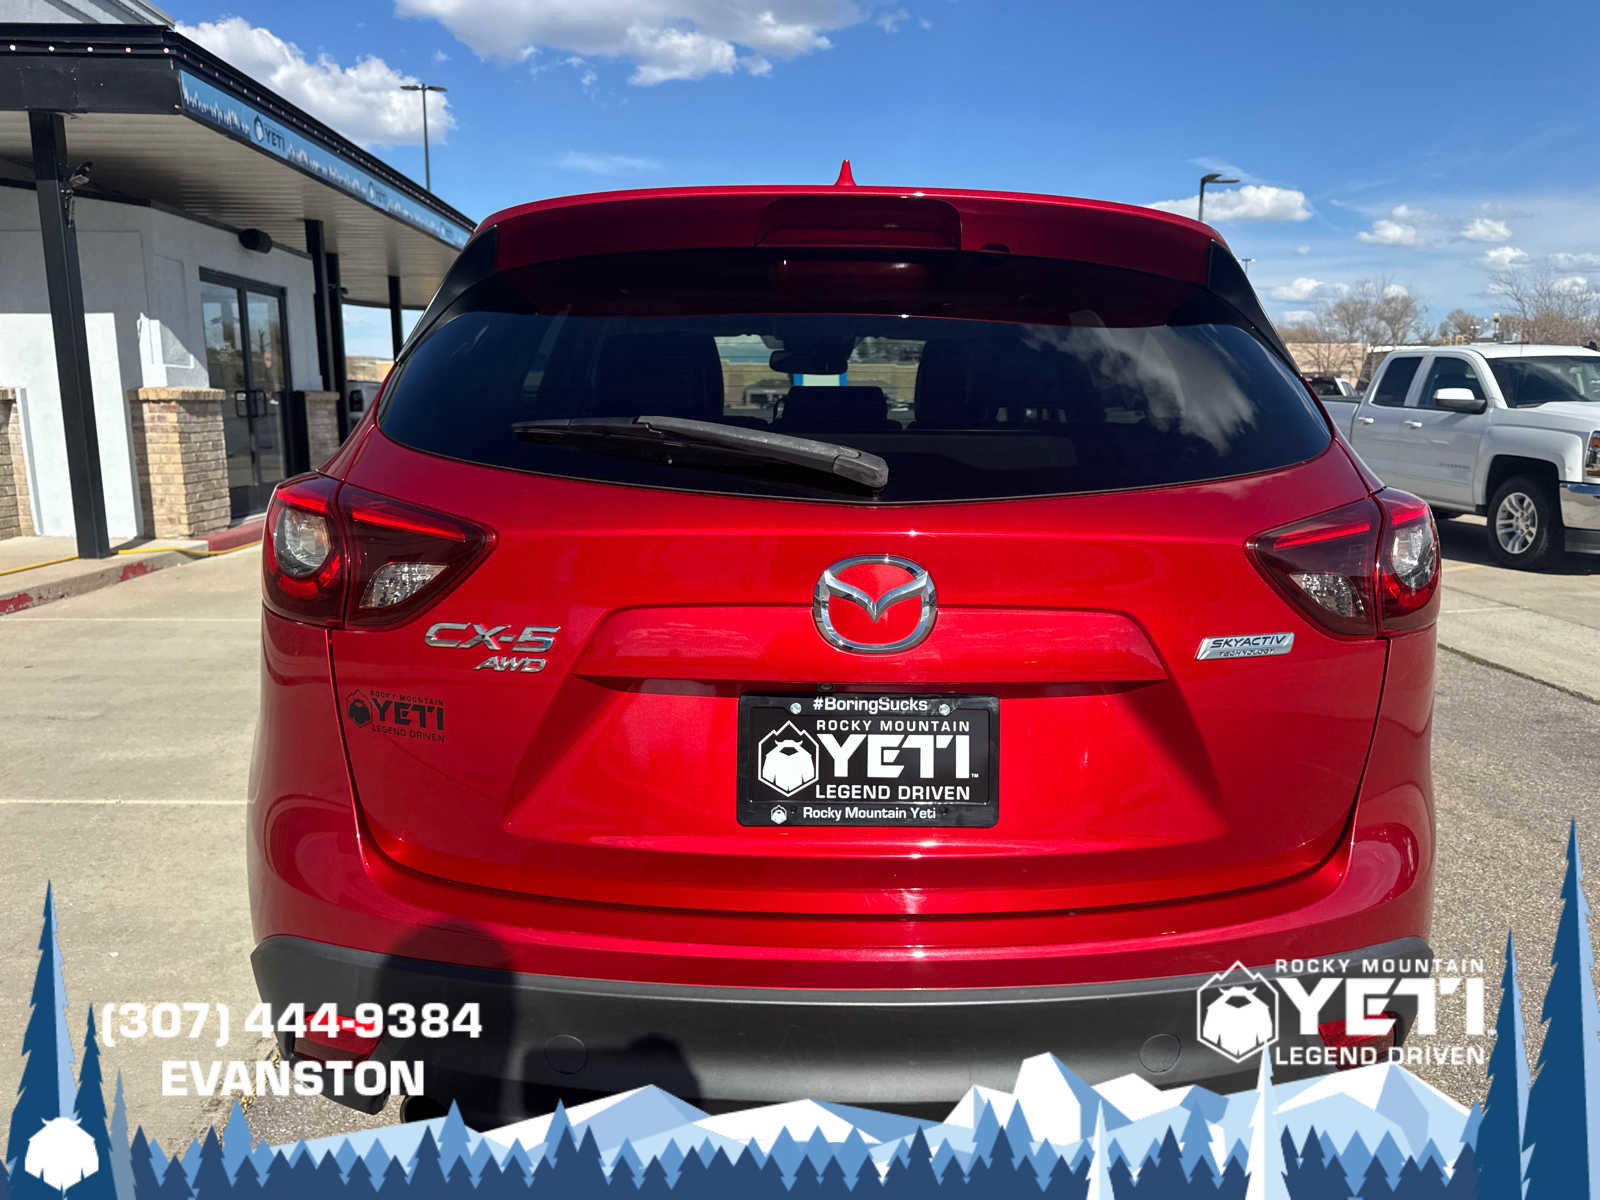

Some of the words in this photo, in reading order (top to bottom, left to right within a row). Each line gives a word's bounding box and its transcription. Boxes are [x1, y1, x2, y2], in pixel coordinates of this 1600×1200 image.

[424, 622, 562, 653] CX-5
[1210, 635, 1287, 649] SKYACTIV
[474, 655, 548, 673] AWD
[369, 690, 395, 700] ROCKY
[399, 694, 444, 706] MOUNTAIN
[813, 696, 928, 714] #BoringSucks
[372, 698, 444, 731] YETI
[372, 724, 406, 737] LEGEND
[408, 728, 445, 743] DRIVEN
[816, 720, 872, 731] ROCKY
[880, 720, 970, 733] MOUNTAIN
[816, 733, 970, 779] YETI
[816, 785, 891, 800] LEGEND
[898, 786, 970, 801] DRIVEN
[803, 807, 843, 821] Rocky
[845, 807, 906, 819] Mountain
[909, 807, 936, 819] Yeti
